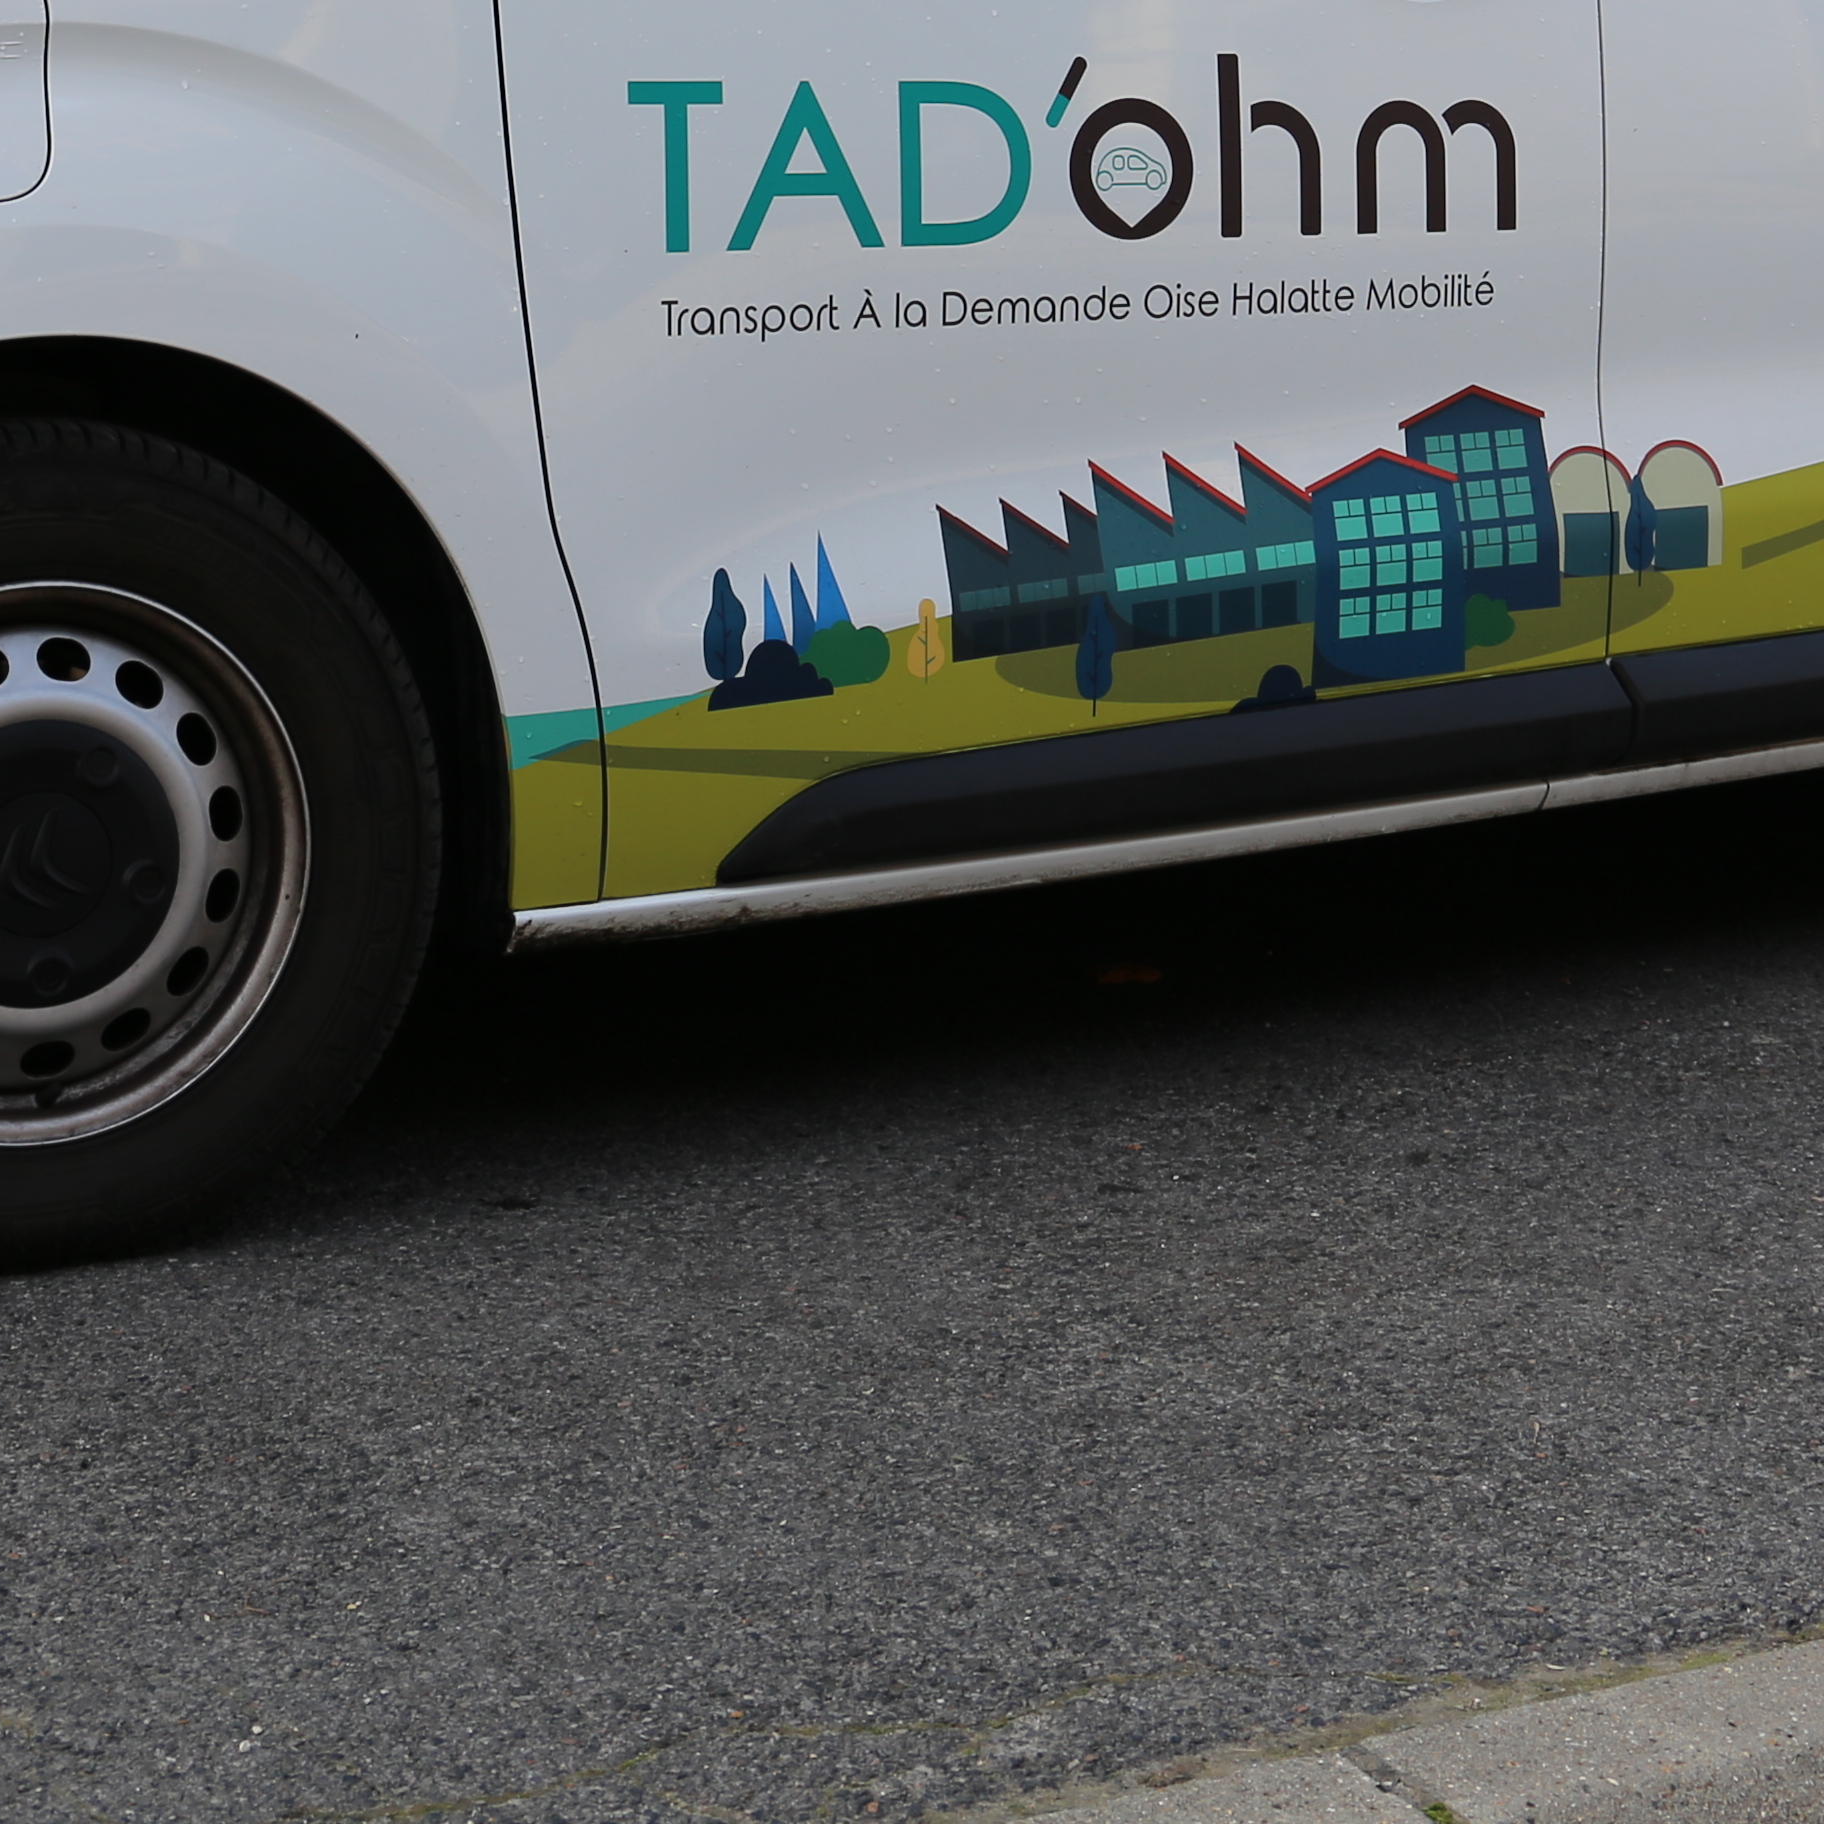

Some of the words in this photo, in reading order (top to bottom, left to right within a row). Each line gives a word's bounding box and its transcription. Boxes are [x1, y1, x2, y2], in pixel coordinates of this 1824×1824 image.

[661, 294, 840, 343] Transport
[852, 288, 882, 330] À
[895, 292, 927, 329] la
[941, 285, 1131, 327] Demande
[1143, 282, 1220, 319] Oise
[1232, 278, 1355, 316] Halatte
[1366, 270, 1495, 311] Mobilité
